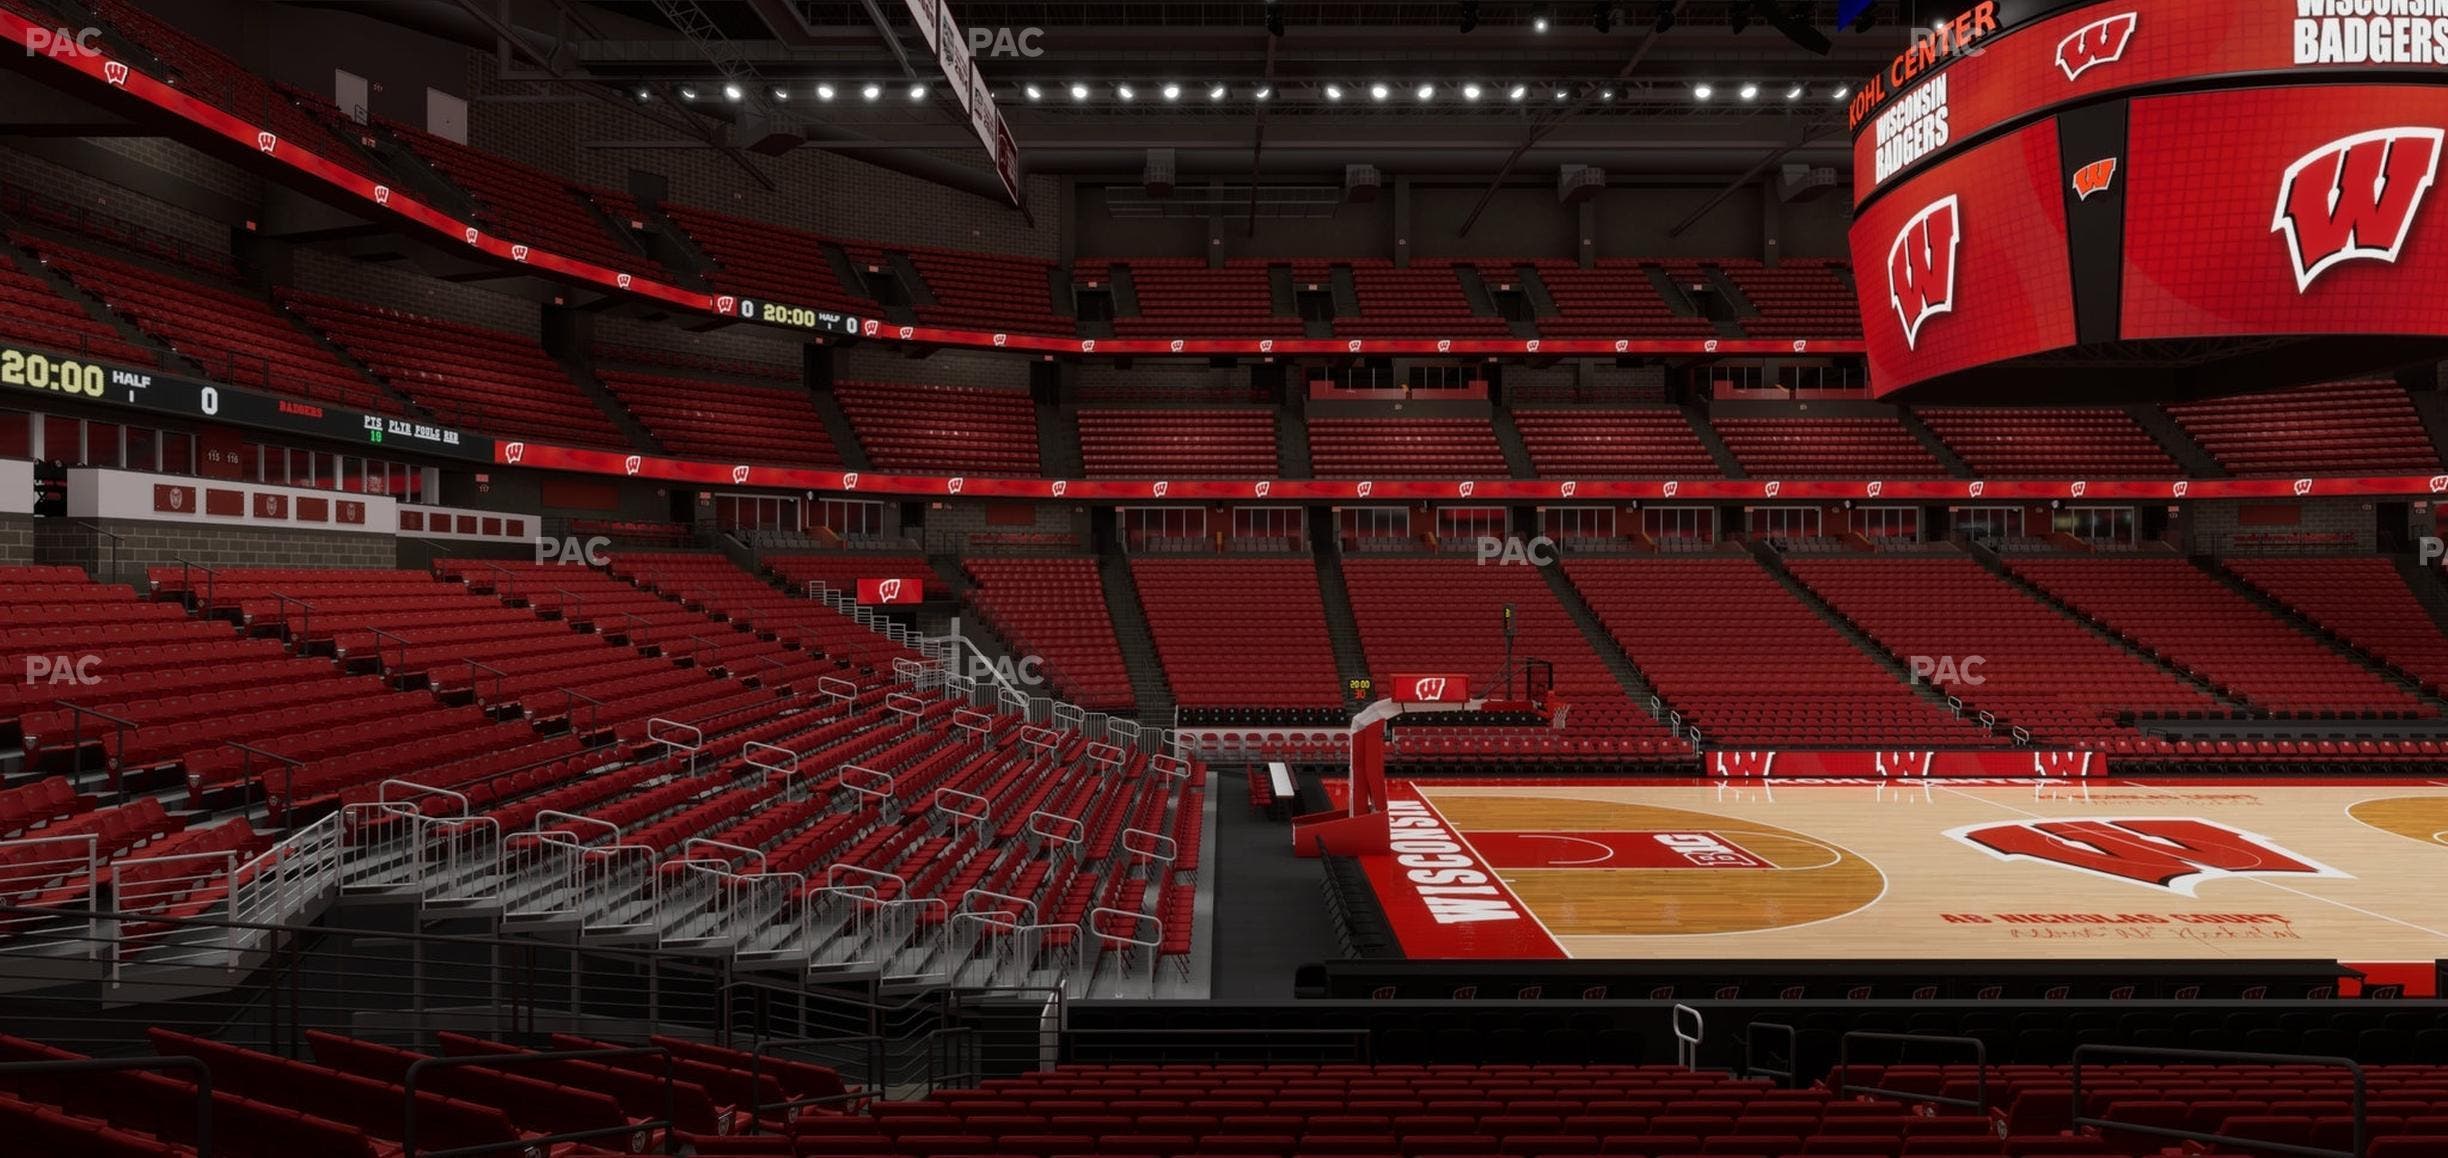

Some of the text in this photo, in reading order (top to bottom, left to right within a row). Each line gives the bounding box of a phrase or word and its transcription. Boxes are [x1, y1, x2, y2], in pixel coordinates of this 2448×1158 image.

[1849, 0, 1997, 132] KOHL CENTER
[2056, 12, 2138, 81] W
[2294, 17, 2448, 64] BADGERS
[1876, 72, 1947, 147] WISCONSIN
[1876, 106, 1949, 185] BADGERS
[2073, 157, 2117, 201] W
[2270, 126, 2445, 294] W
[1888, 194, 1960, 351] W
[742, 300, 858, 333] 0 20:00 HALF 0
[2, 350, 104, 397] 20:00
[112, 370, 151, 388] HALF
[201, 386, 218, 415] 0
[364, 415, 383, 430] PTS
[388, 420, 412, 435] PLYR
[414, 425, 441, 440] FOULS
[1350, 680, 1370, 689] 20:00
[1387, 801, 1520, 924] WISCONSIN
[1942, 817, 2358, 898] W
[1940, 914, 2291, 924] AB NICHOLAS COURT
